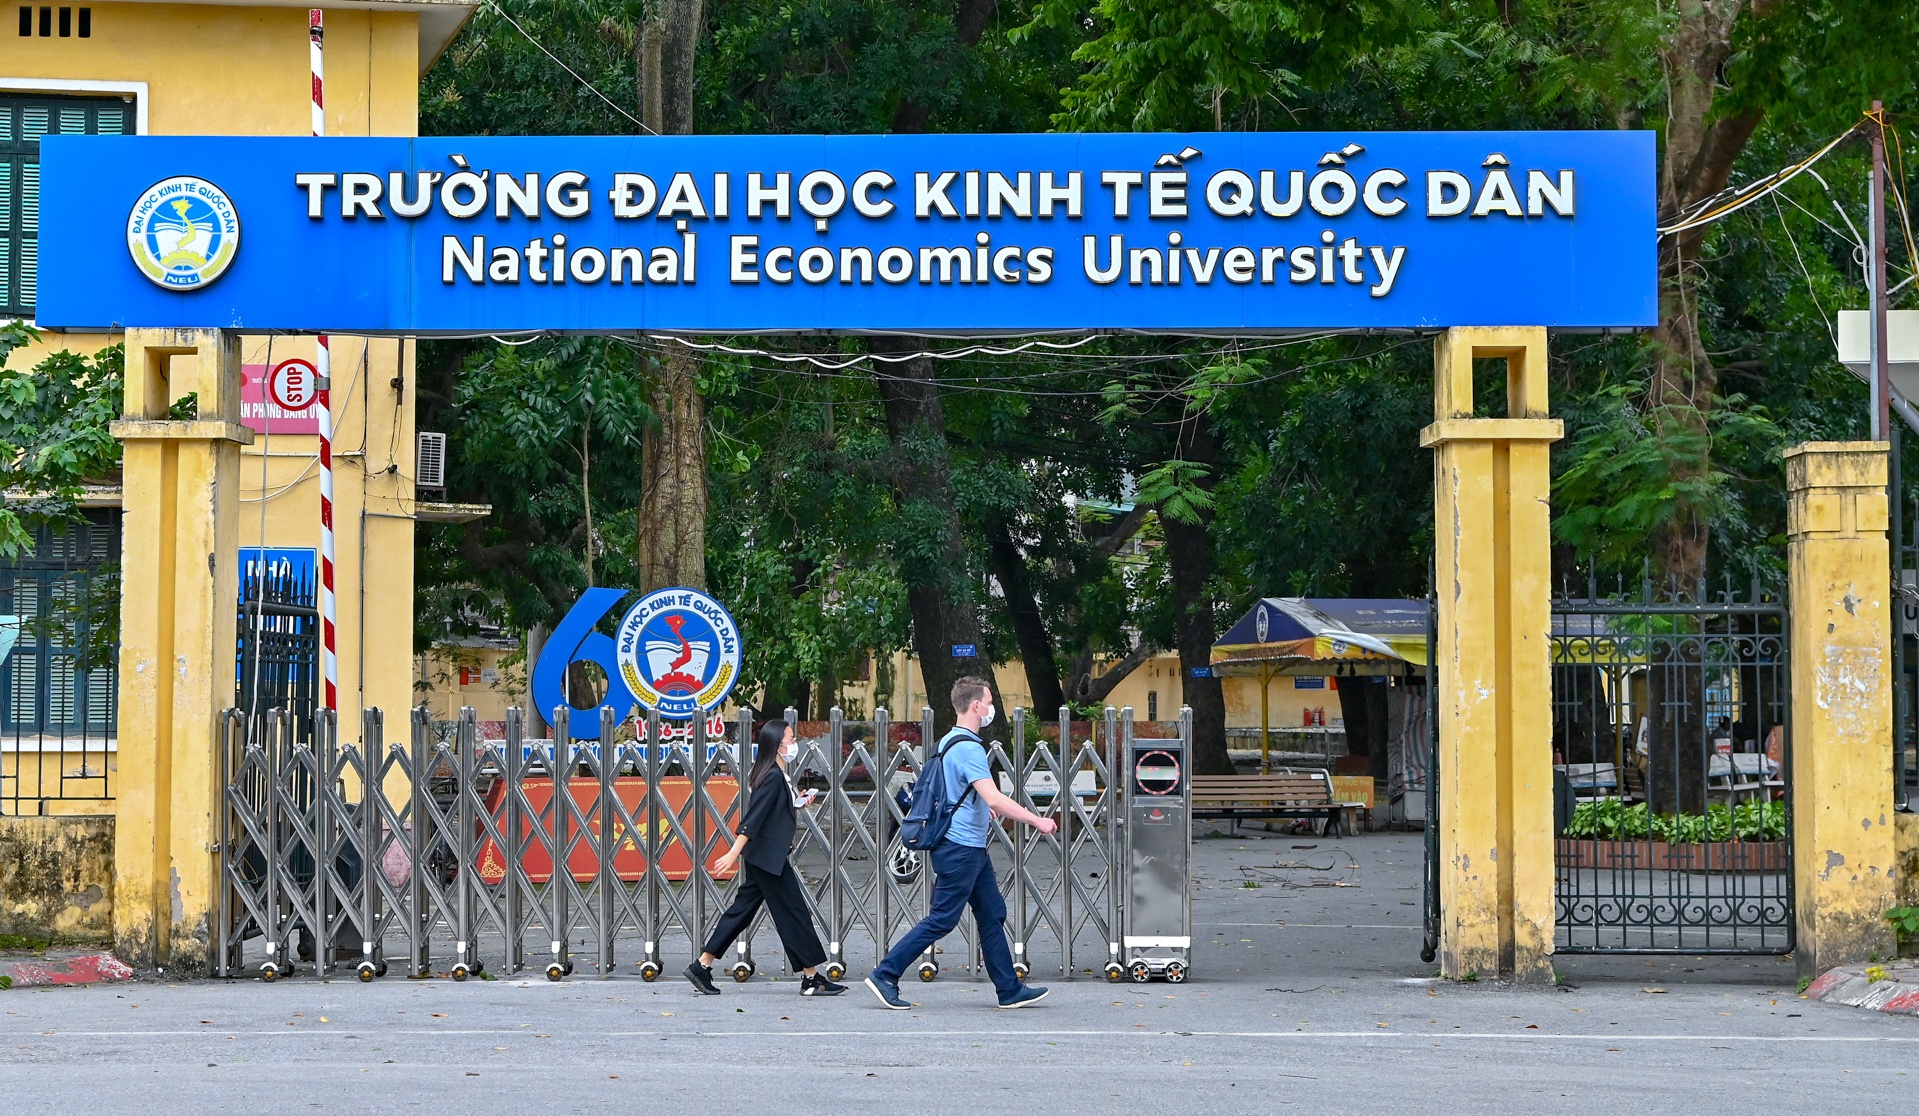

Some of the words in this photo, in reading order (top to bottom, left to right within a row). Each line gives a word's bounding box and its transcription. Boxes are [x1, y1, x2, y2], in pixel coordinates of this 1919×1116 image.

[133, 215, 144, 234] ĐẠI
[140, 194, 158, 215] HỌC
[158, 183, 182, 198] KINH
[184, 181, 198, 193] TẾ
[198, 186, 226, 211] QUỐC
[222, 210, 235, 234] DÂN
[295, 154, 592, 219] TRƯỜNG
[609, 171, 731, 232] ĐẠI
[746, 169, 897, 232] HỌC
[914, 170, 1083, 219] KINH
[1101, 146, 1203, 218] TẾ
[1205, 142, 1409, 218] QUỐC
[1426, 152, 1576, 218] DÂN
[166, 275, 198, 284] NEU
[442, 232, 698, 285] National
[729, 231, 1055, 285] Economics
[1082, 229, 1408, 298] University
[287, 366, 303, 403] STOP
[621, 631, 635, 653] ĐẠI
[628, 607, 650, 632] HỌC
[649, 595, 676, 612] KINH
[678, 593, 694, 607] TẾ
[693, 599, 724, 628] QUỐC
[719, 626, 735, 654] DÂN
[660, 702, 695, 711] NEU
